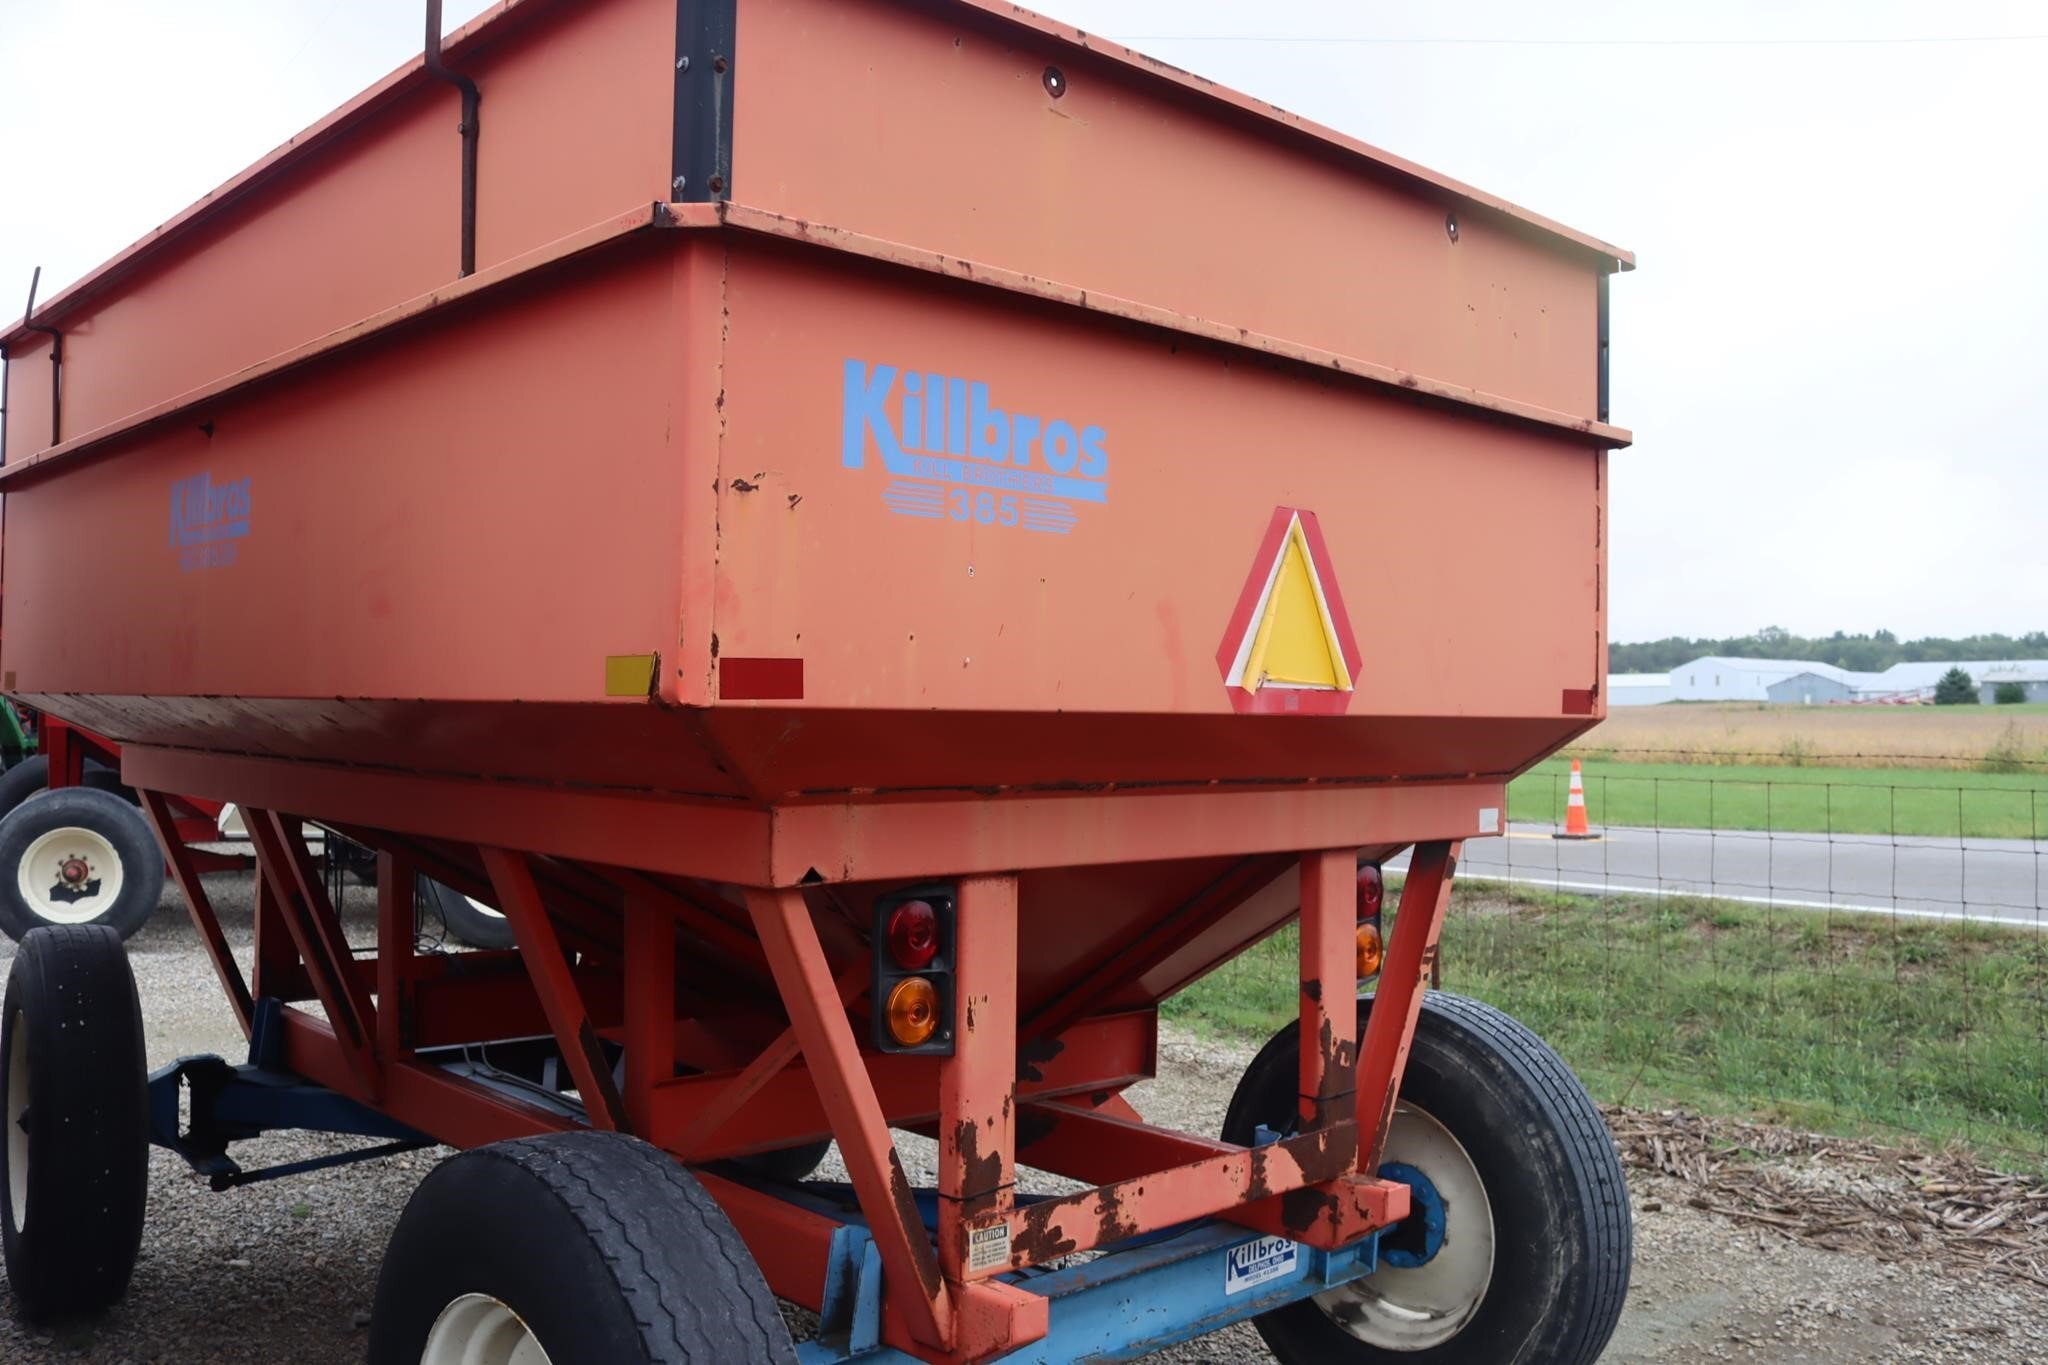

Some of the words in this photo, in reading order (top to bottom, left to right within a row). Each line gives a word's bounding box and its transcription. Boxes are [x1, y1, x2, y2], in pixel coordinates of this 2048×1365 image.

[842, 358, 1109, 477] Killbros
[950, 489, 1019, 527] 385
[974, 1227, 1005, 1242] CAUTION
[1228, 1240, 1292, 1281] Killbros
